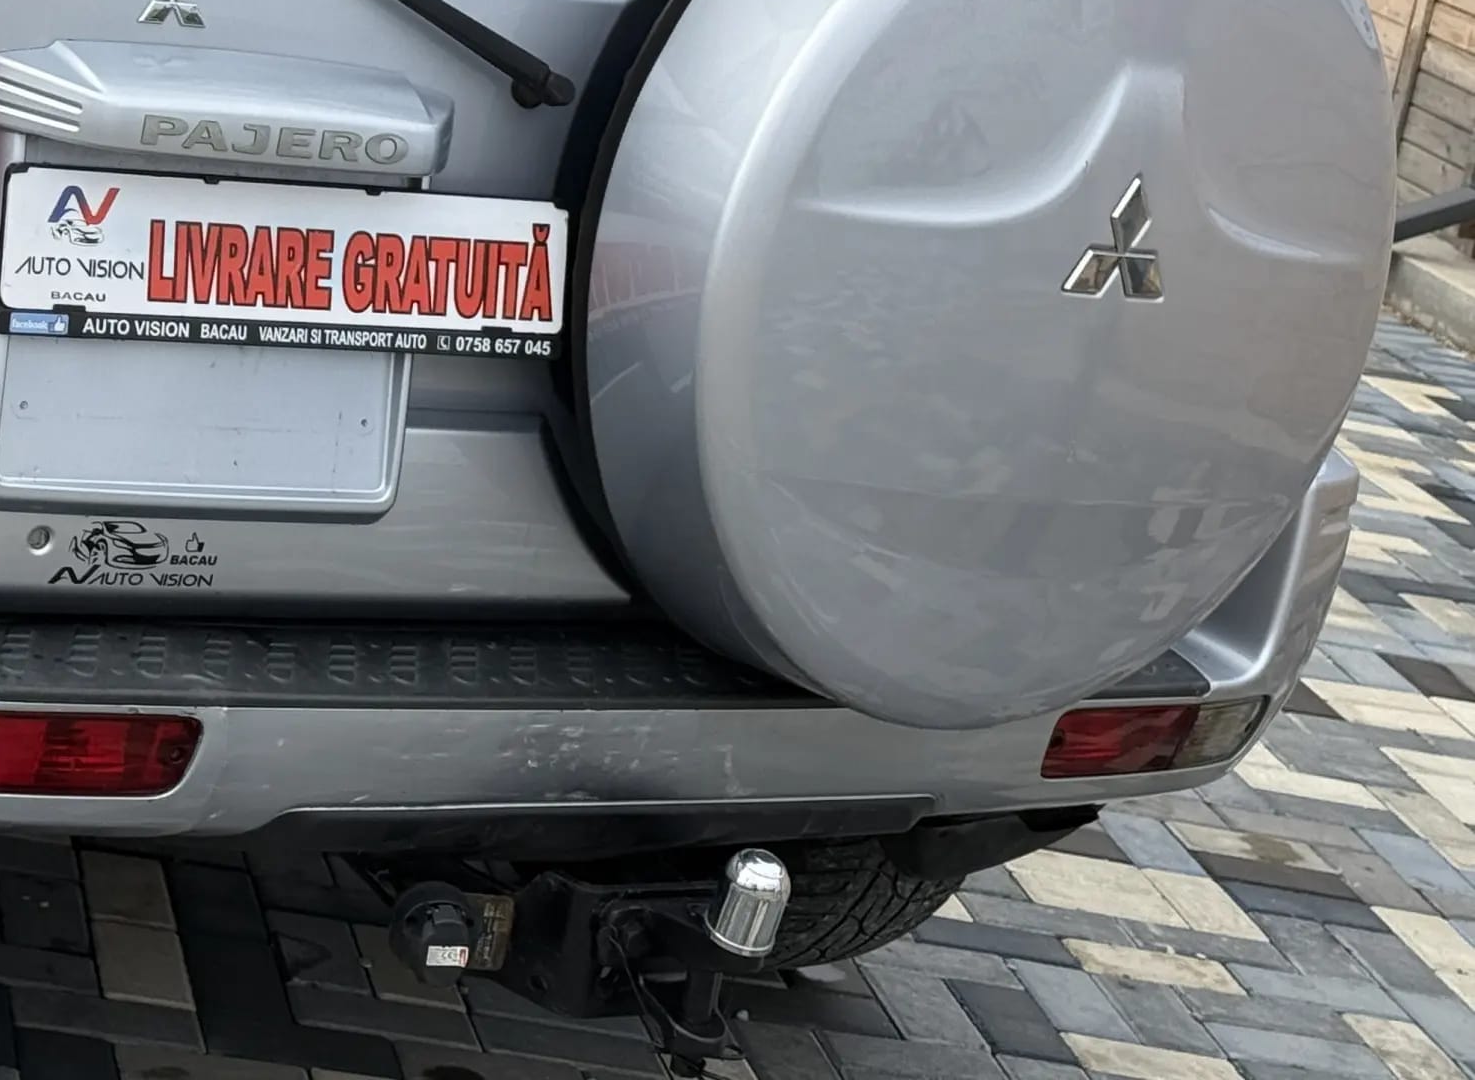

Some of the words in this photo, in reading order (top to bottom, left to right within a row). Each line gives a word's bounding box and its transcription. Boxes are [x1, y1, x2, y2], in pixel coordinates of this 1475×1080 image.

[140, 114, 409, 166] PAJERO
[14, 255, 72, 276] AUTO
[76, 257, 145, 280] VISION
[147, 219, 334, 311] LIVRARE
[342, 223, 553, 321] GRATUITĂ
[50, 291, 106, 302] BACAU
[82, 318, 130, 336] AUTO
[134, 320, 190, 338] VISION
[200, 324, 248, 341] BACAU
[259, 326, 308, 344] VANZARI
[310, 328, 322, 344] SI
[324, 329, 394, 348] TRANSPORT
[395, 333, 427, 349] AUTO
[456, 336, 491, 353] 0758
[494, 338, 520, 354] 657
[525, 340, 551, 356] 045
[170, 554, 217, 567] BACAU
[87, 572, 144, 586] AUTO
[149, 573, 214, 587] VISION
